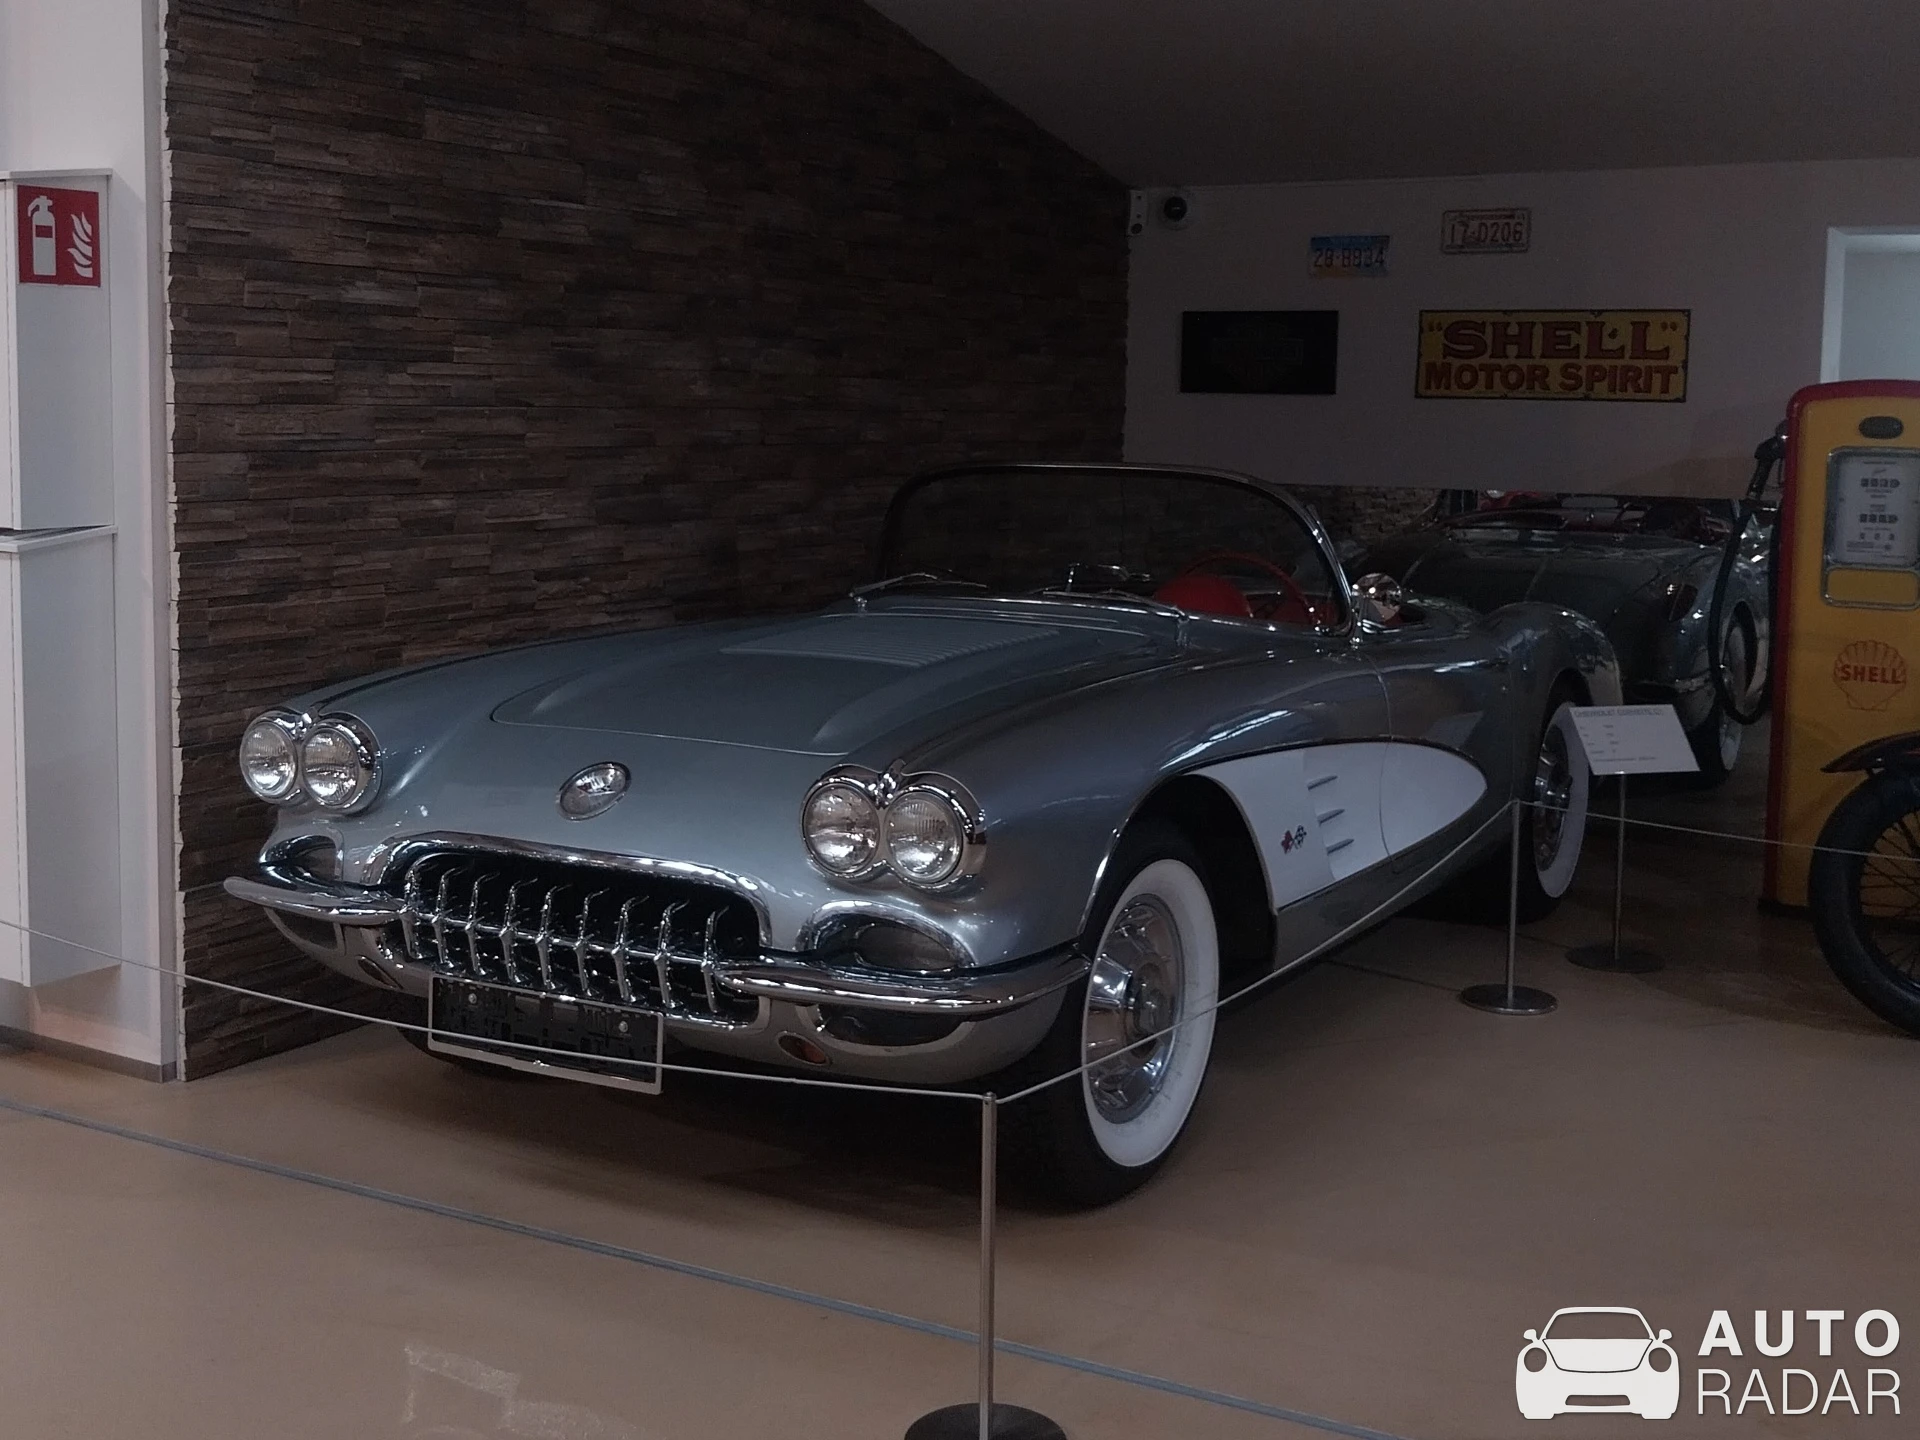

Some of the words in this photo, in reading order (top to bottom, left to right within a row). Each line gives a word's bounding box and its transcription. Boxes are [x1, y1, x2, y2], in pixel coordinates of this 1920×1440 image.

[1424, 361, 1550, 391] MOTOR
[1559, 362, 1679, 394] SPIRIT
[1840, 663, 1904, 685] SHELL
